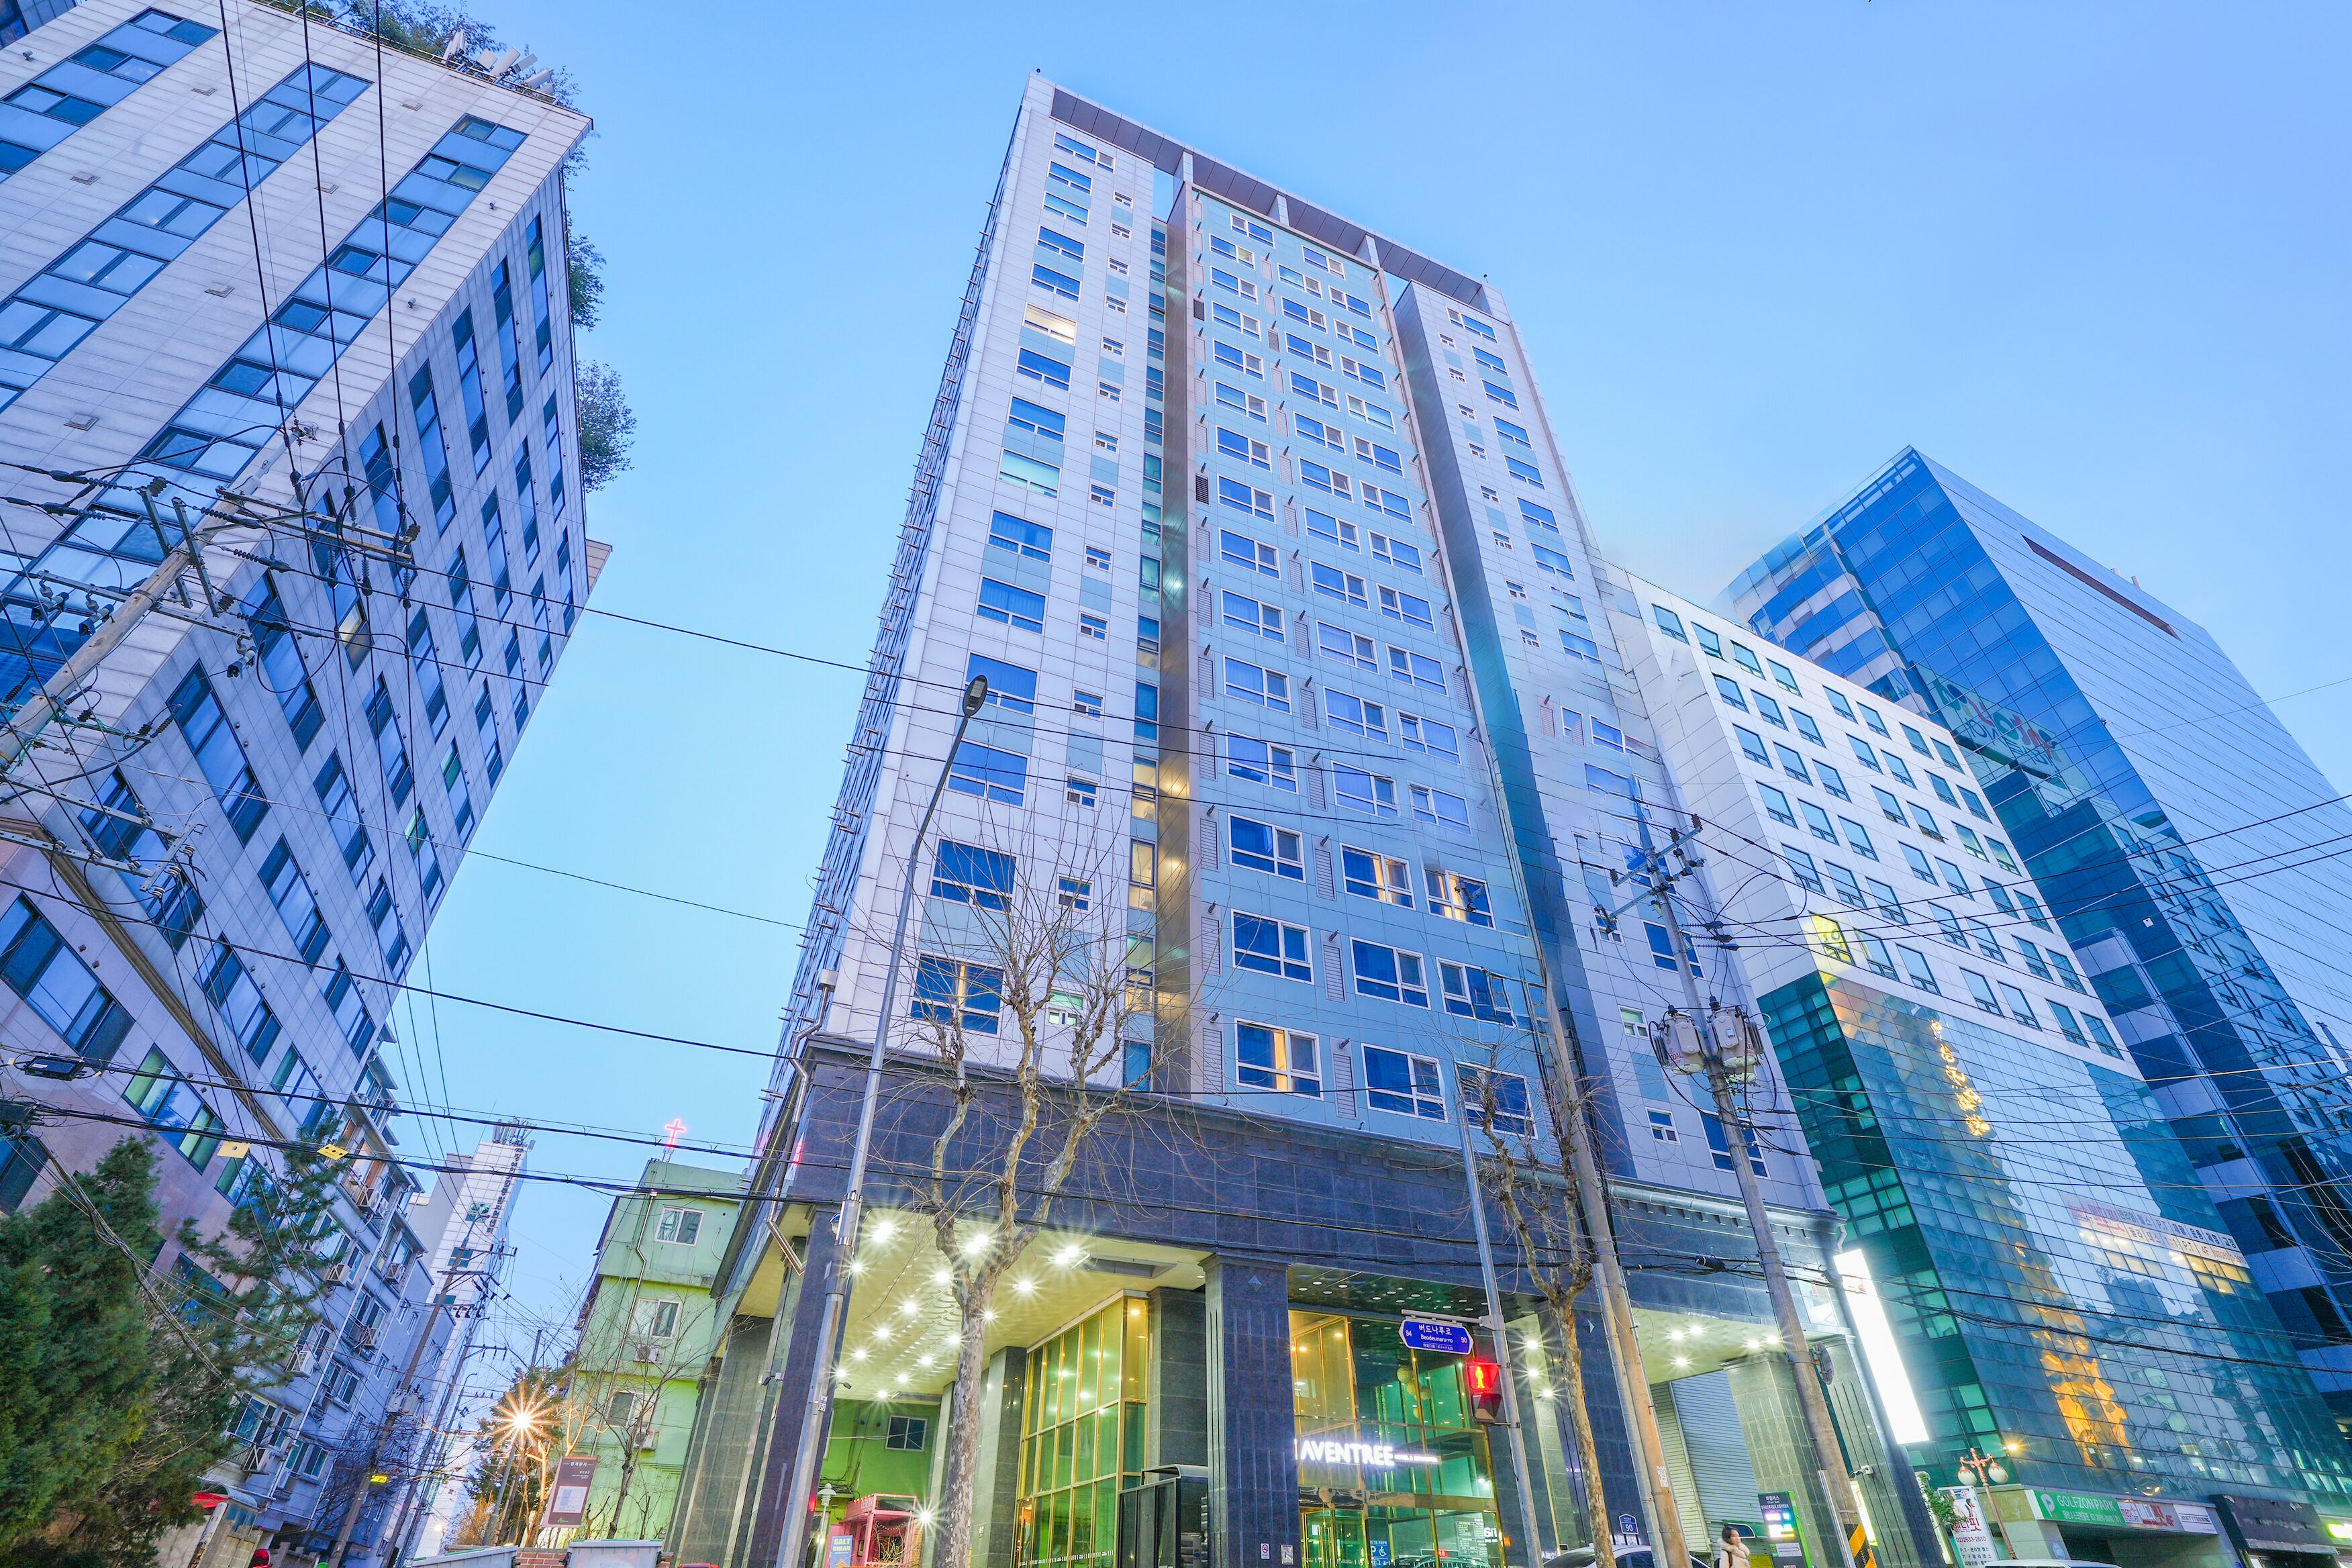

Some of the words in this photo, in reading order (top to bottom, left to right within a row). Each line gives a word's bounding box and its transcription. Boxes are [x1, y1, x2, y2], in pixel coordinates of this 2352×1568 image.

[1418, 1324, 1453, 1336] 버드나루로
[1420, 1334, 1453, 1343] Beodeunaru-ro
[1300, 1440, 1395, 1467] AVENTREE
[1625, 1524, 1633, 1532] 90
